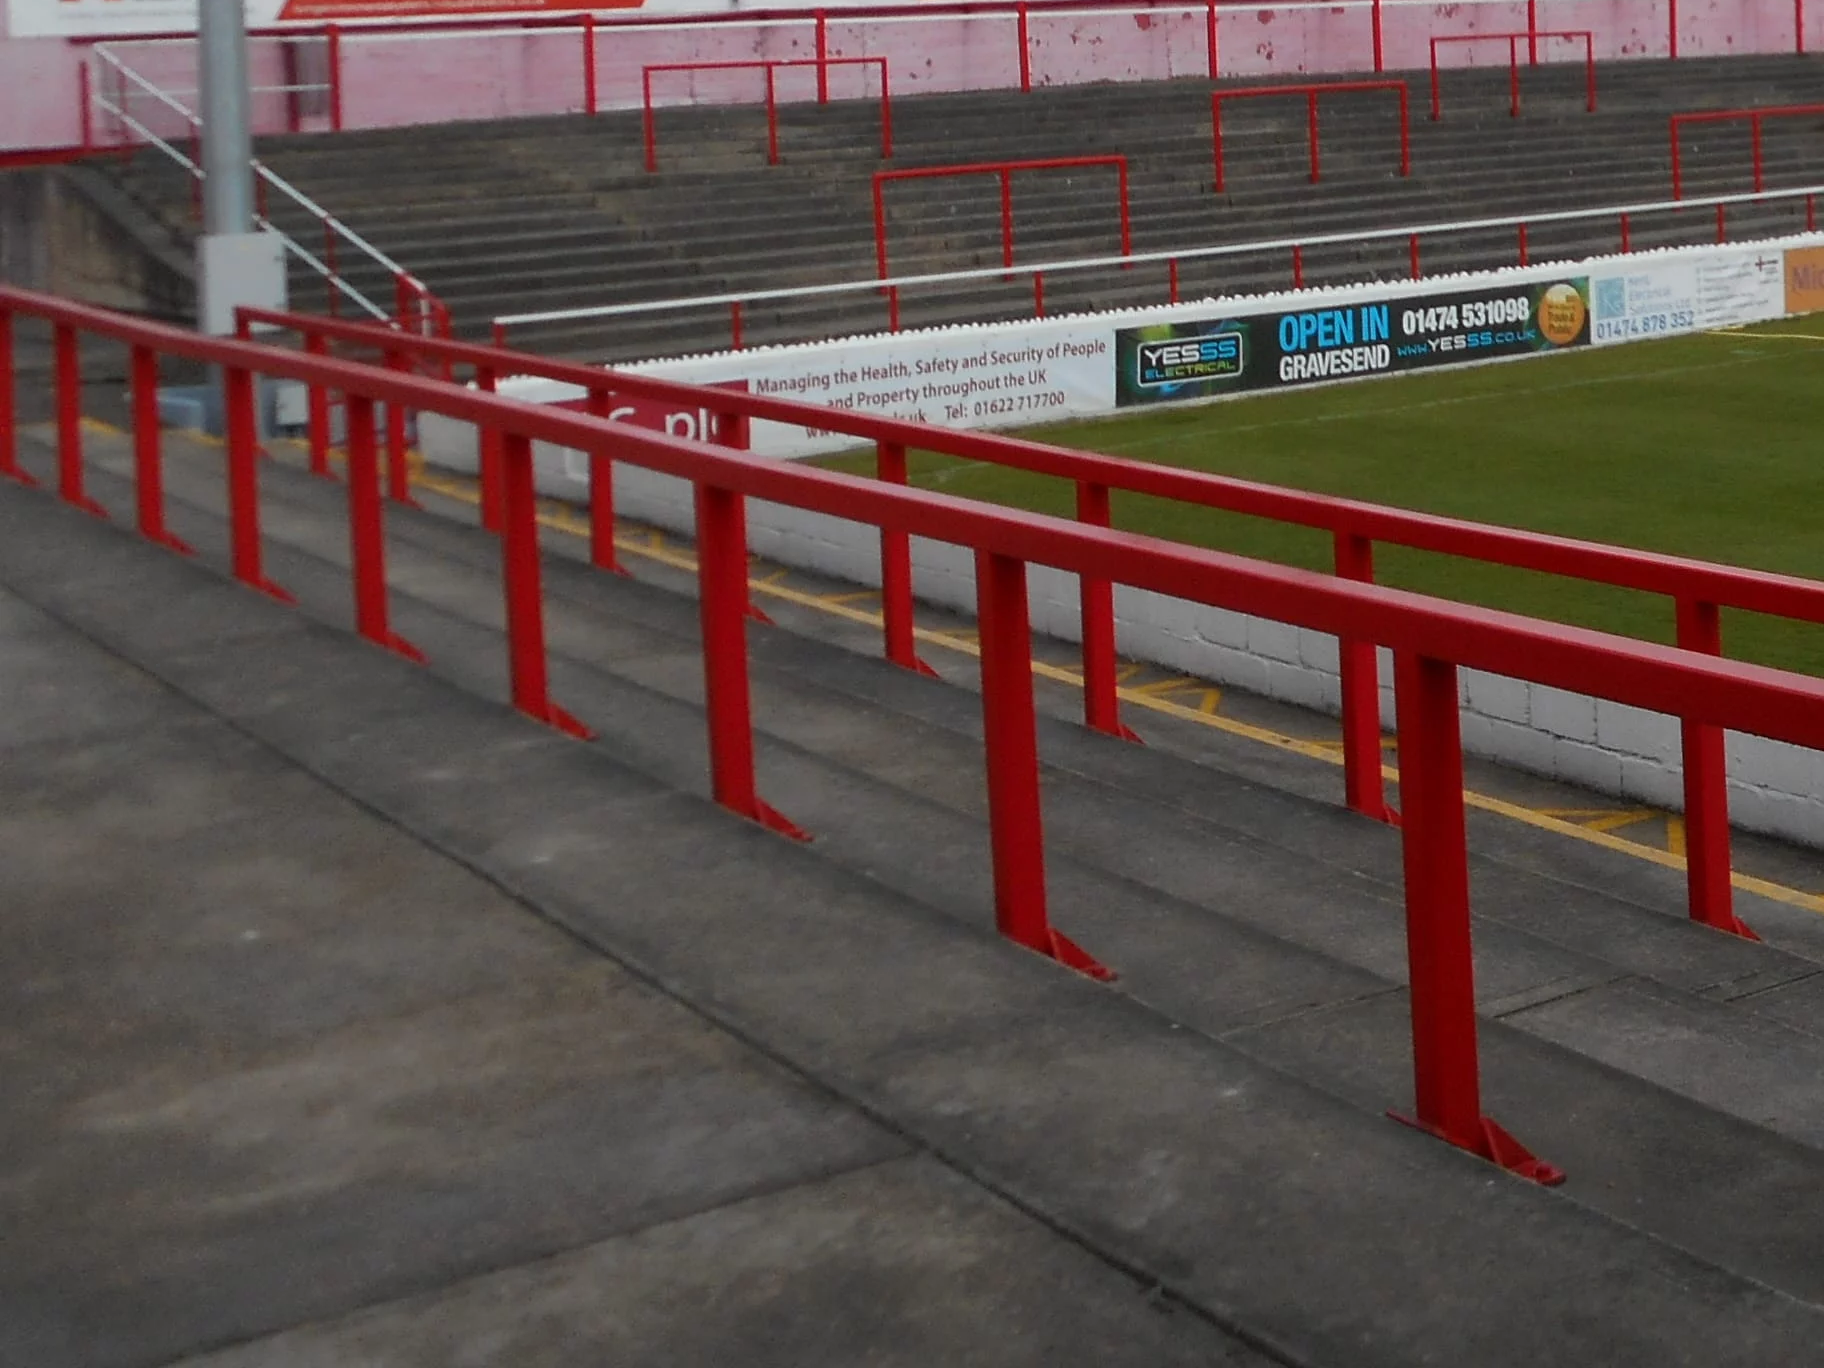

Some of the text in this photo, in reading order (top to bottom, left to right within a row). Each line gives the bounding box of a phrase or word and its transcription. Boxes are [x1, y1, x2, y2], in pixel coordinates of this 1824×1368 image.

[1279, 304, 1389, 352] OPEN IN
[1402, 305, 1459, 335] 01474
[1461, 296, 1530, 328] 531098
[1597, 310, 1694, 338] 01474 878 352
[756, 339, 1106, 396] Managing the Health, Safety and Security of People
[1144, 340, 1236, 367] YESSS
[1145, 360, 1235, 380] ELECTRICAL
[1280, 344, 1390, 382] GRAVESEND
[857, 386, 920, 409] Property
[922, 376, 1000, 401] throughout
[1004, 372, 1025, 388] the
[1028, 369, 1048, 385] UK
[945, 391, 1065, 420] Tel: 01622 717700
